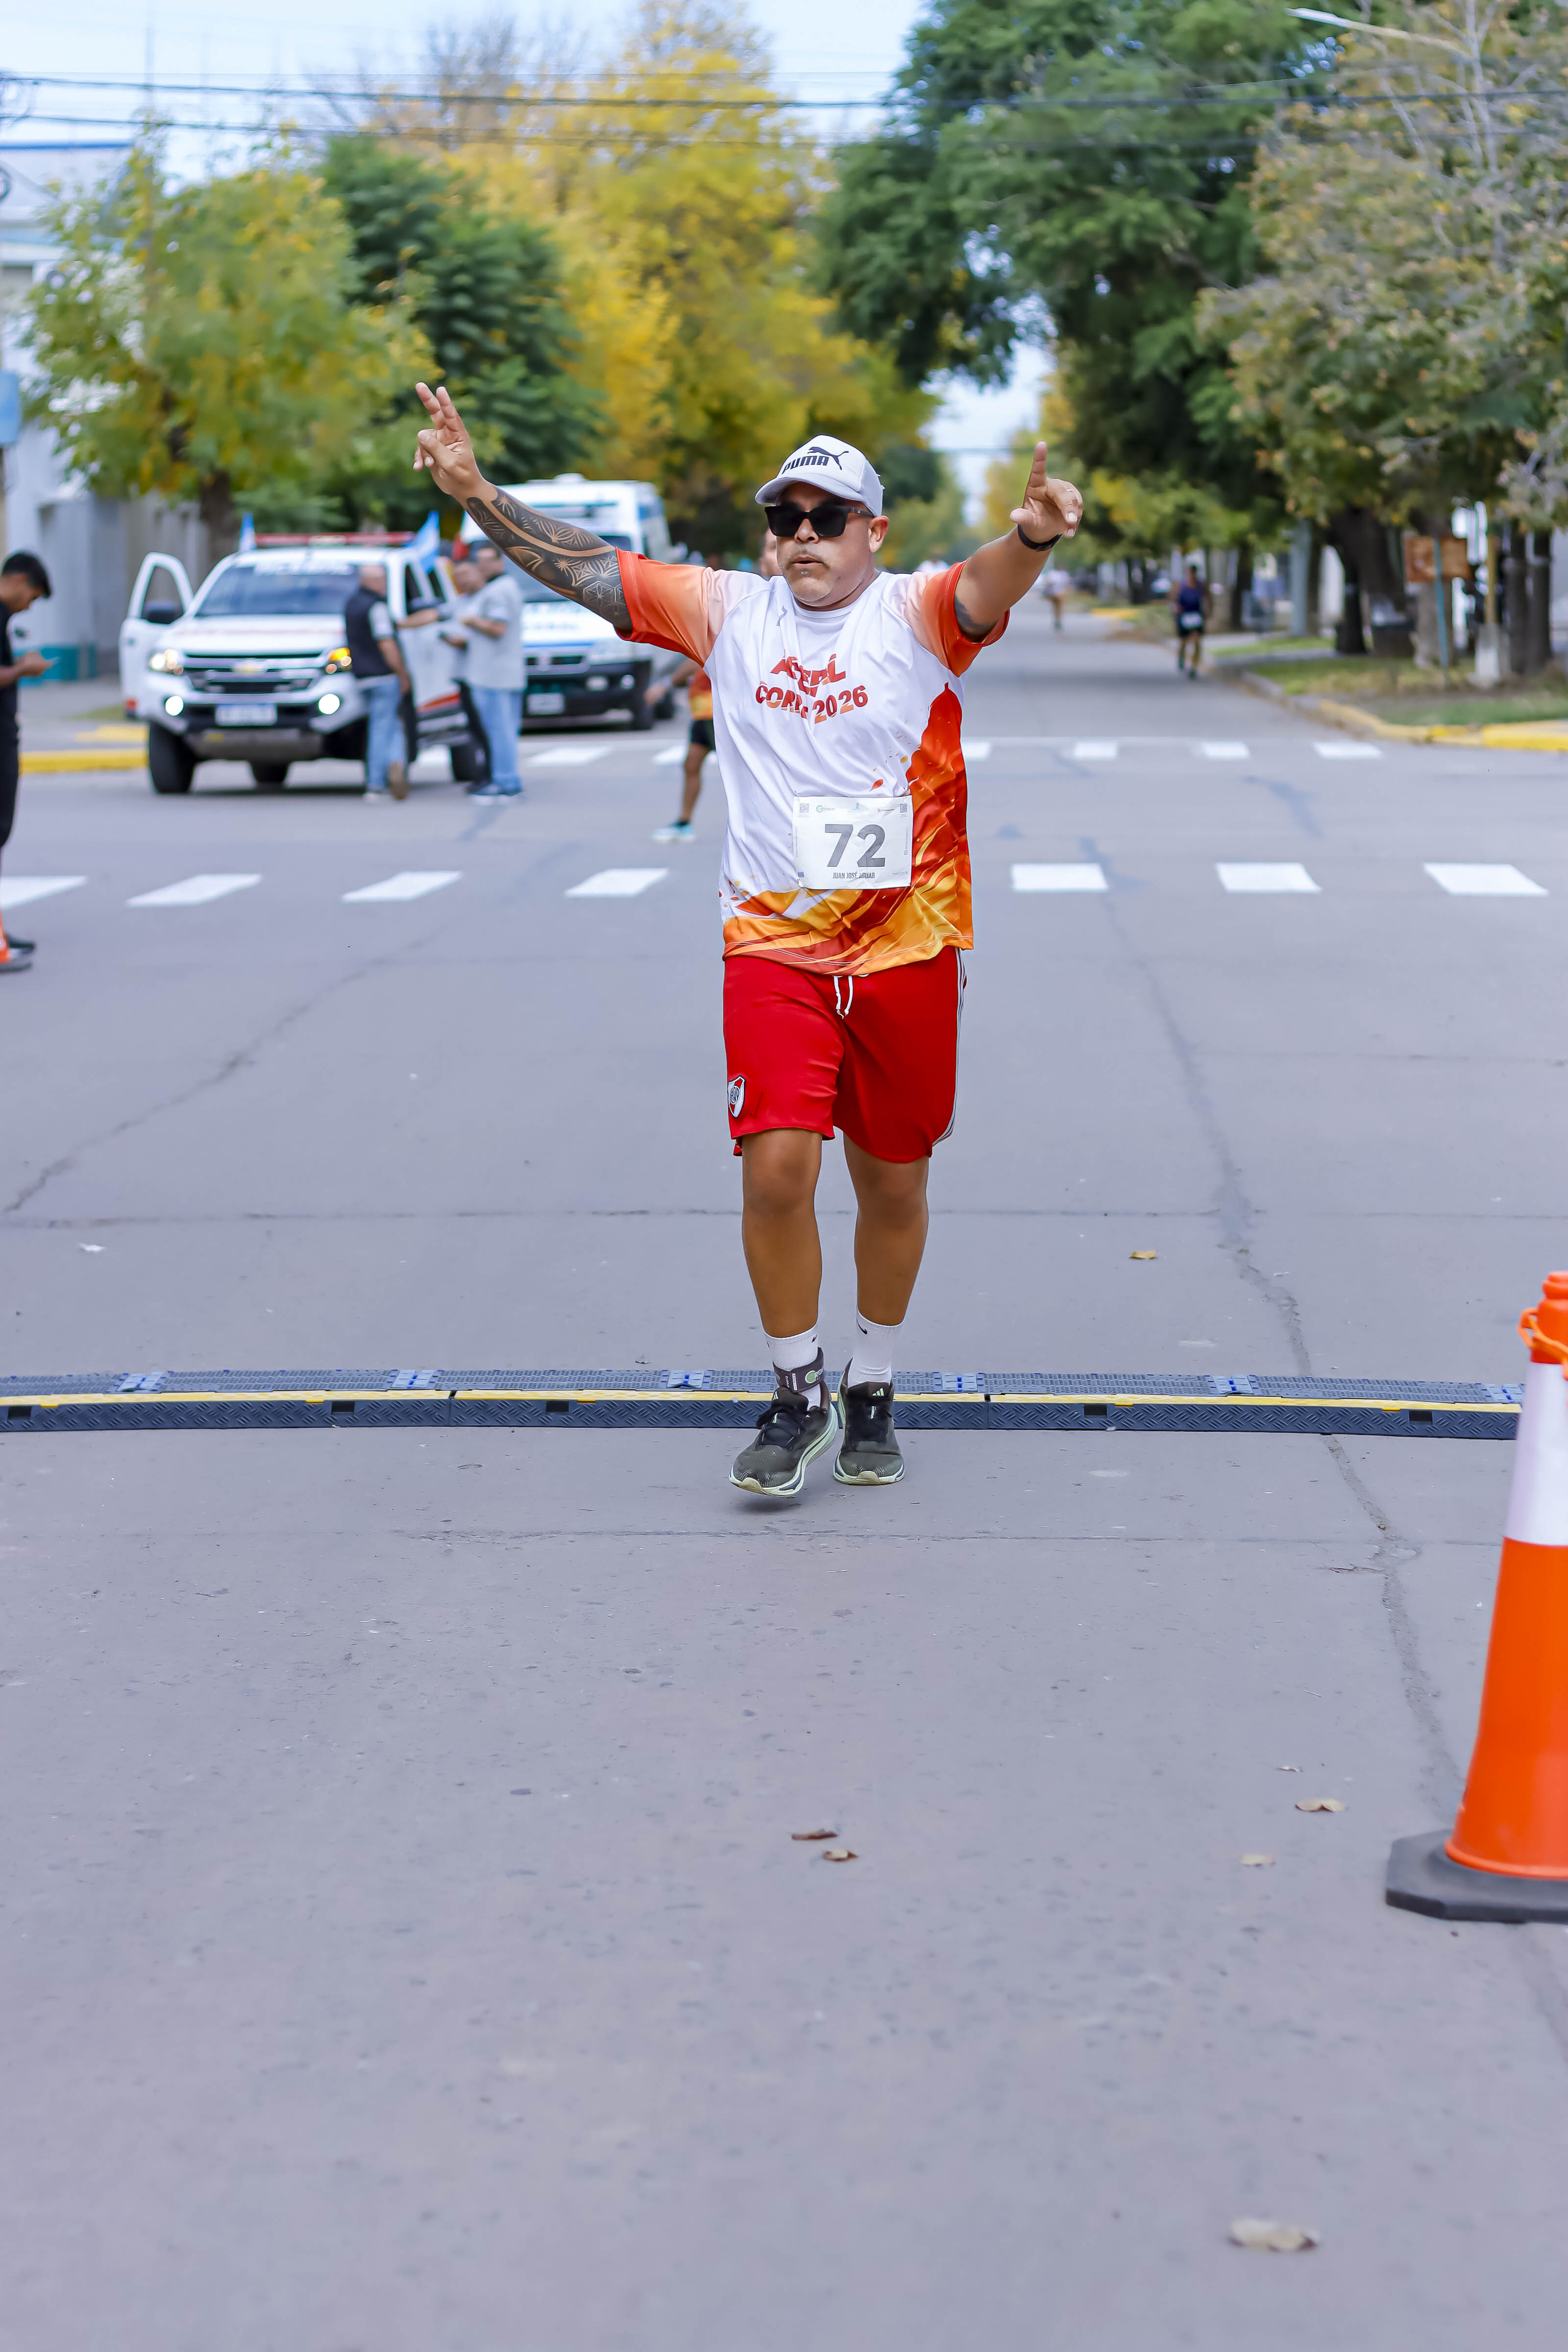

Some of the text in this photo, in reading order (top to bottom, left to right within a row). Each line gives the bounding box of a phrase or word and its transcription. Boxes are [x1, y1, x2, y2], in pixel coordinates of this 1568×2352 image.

[782, 456, 830, 474] PUMA
[812, 685, 868, 724] 2026
[825, 824, 885, 867] 72
